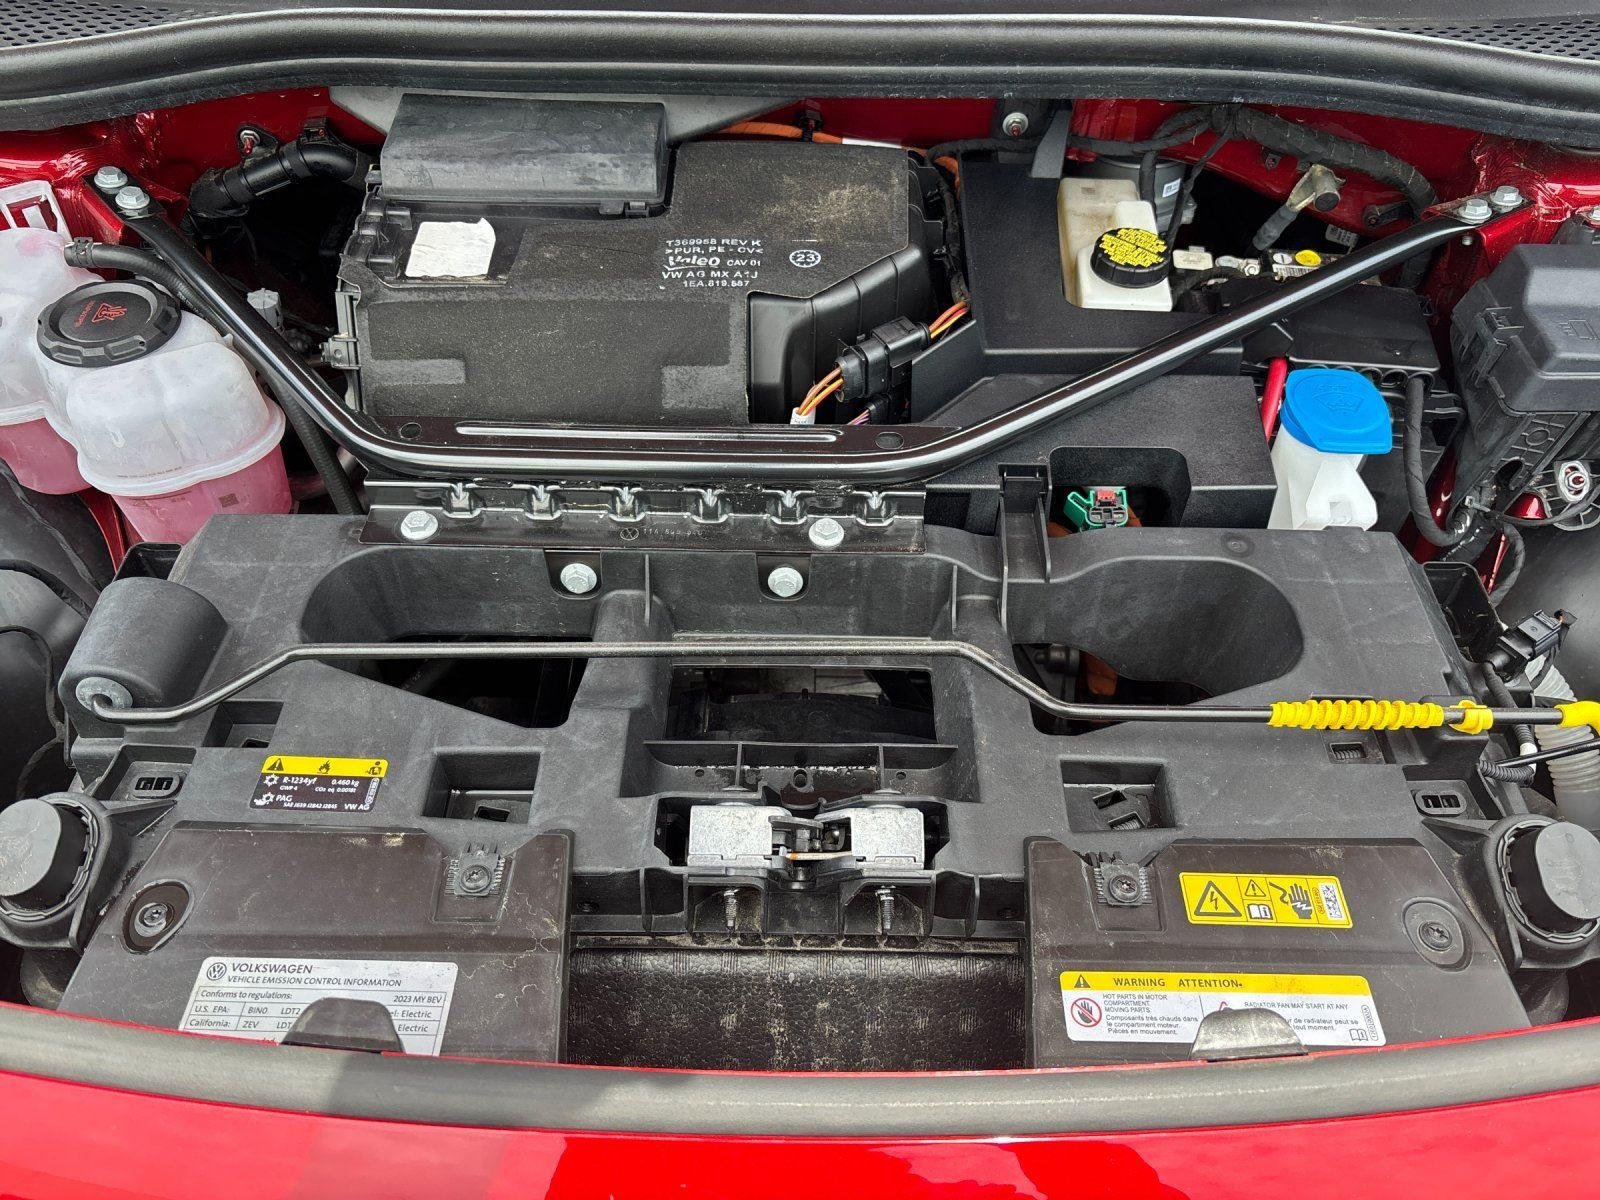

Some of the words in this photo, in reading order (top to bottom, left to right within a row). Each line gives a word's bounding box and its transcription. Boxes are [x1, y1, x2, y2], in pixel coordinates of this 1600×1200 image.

[795, 253, 816, 262] 23
[661, 271, 683, 280] VW
[282, 776, 318, 786] R-1234yf
[231, 963, 313, 974] VOLKSWAGEN
[228, 975, 261, 984] VEHICLE
[261, 976, 303, 985] EMISSION
[303, 977, 341, 986] CONTROL
[343, 979, 402, 987] INFORMATION
[1113, 977, 1166, 987] WARNING
[200, 990, 238, 998] Conforms
[247, 991, 292, 1000] regulations:
[393, 995, 412, 1003] 2023
[1244, 1001, 1277, 1009] RADIATOR
[401, 1010, 432, 1018] Electric
[1106, 1014, 1144, 1022] Composants
[189, 1019, 231, 1027] California:
[397, 1024, 429, 1032] Electric
